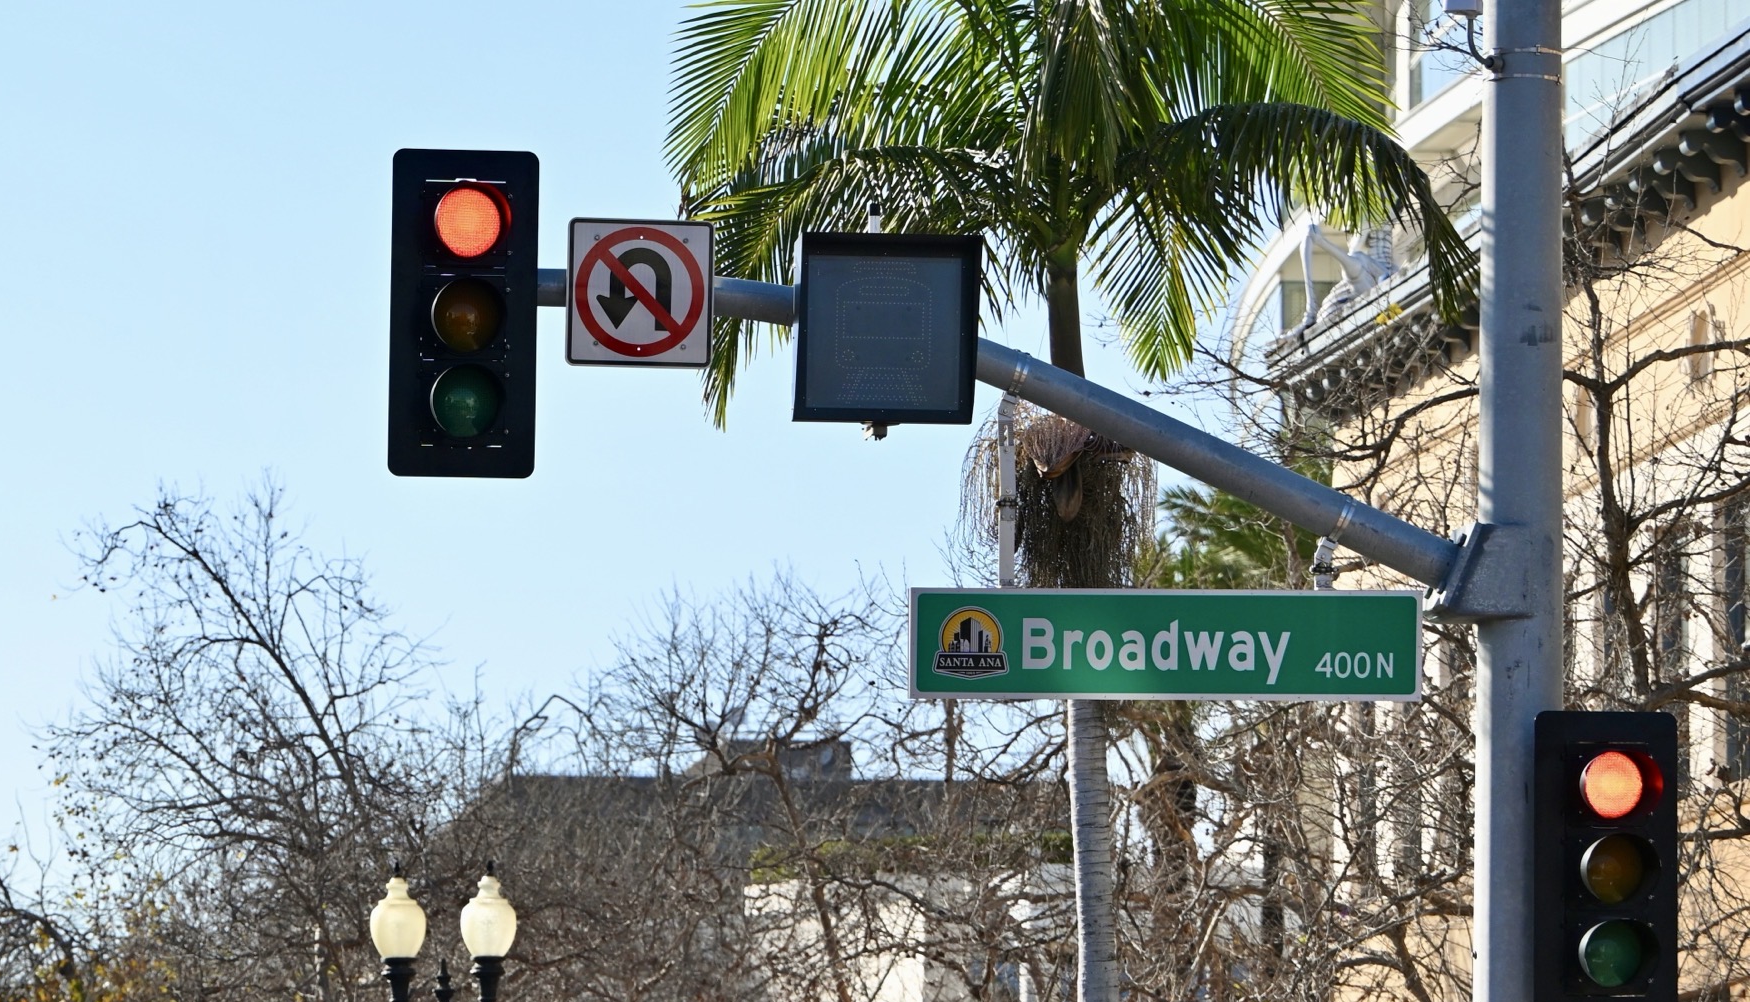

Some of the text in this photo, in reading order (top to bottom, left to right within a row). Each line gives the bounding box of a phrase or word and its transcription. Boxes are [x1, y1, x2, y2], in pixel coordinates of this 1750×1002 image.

[939, 657, 1002, 667] SANTA ANA
[1022, 618, 1291, 686] Broadway
